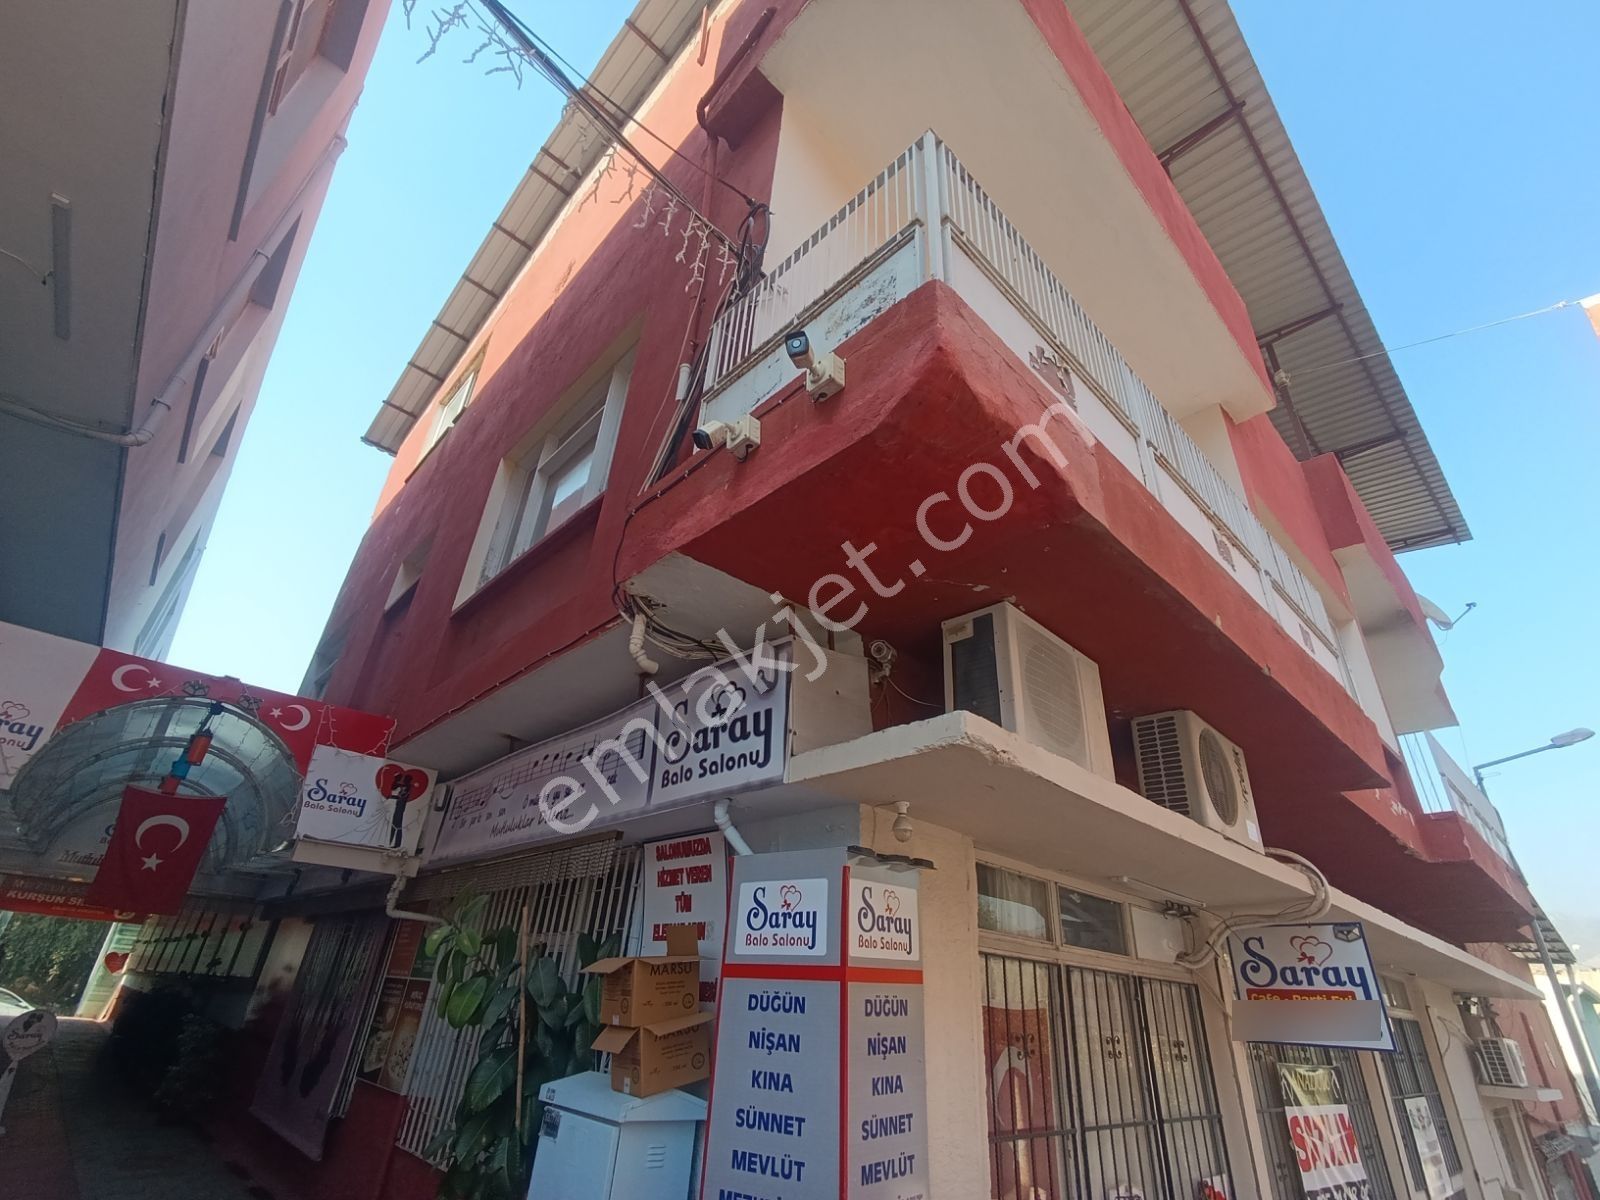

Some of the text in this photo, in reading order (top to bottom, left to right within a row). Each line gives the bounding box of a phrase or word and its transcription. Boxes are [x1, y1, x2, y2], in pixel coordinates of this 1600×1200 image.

[0, 718, 44, 751] ray
[0, 737, 26, 748] onu
[664, 699, 772, 768] Saray
[661, 749, 761, 789] Balo Salonu
[303, 800, 359, 817] Balo Salonu
[307, 778, 367, 817] Saray
[746, 886, 818, 950] Saray
[857, 886, 913, 955] Saray
[745, 933, 810, 947] Balo Salonu
[858, 934, 908, 952] Balo Salonu
[650, 962, 692, 977] MARSU
[1240, 936, 1373, 1000] Saray
[747, 990, 806, 1014] DÜĞÜN
[864, 994, 908, 1018] DÜĞÜN
[748, 1027, 801, 1056] NİŞAN
[867, 1032, 907, 1060] NİŞAN
[751, 1069, 794, 1093] KINA
[871, 1074, 904, 1097] KINA
[735, 1105, 806, 1137] SÜNNET
[861, 1112, 914, 1141] SÜNNET
[731, 1149, 806, 1182] MEVLÜT
[860, 1152, 916, 1186] MEVLÜT
